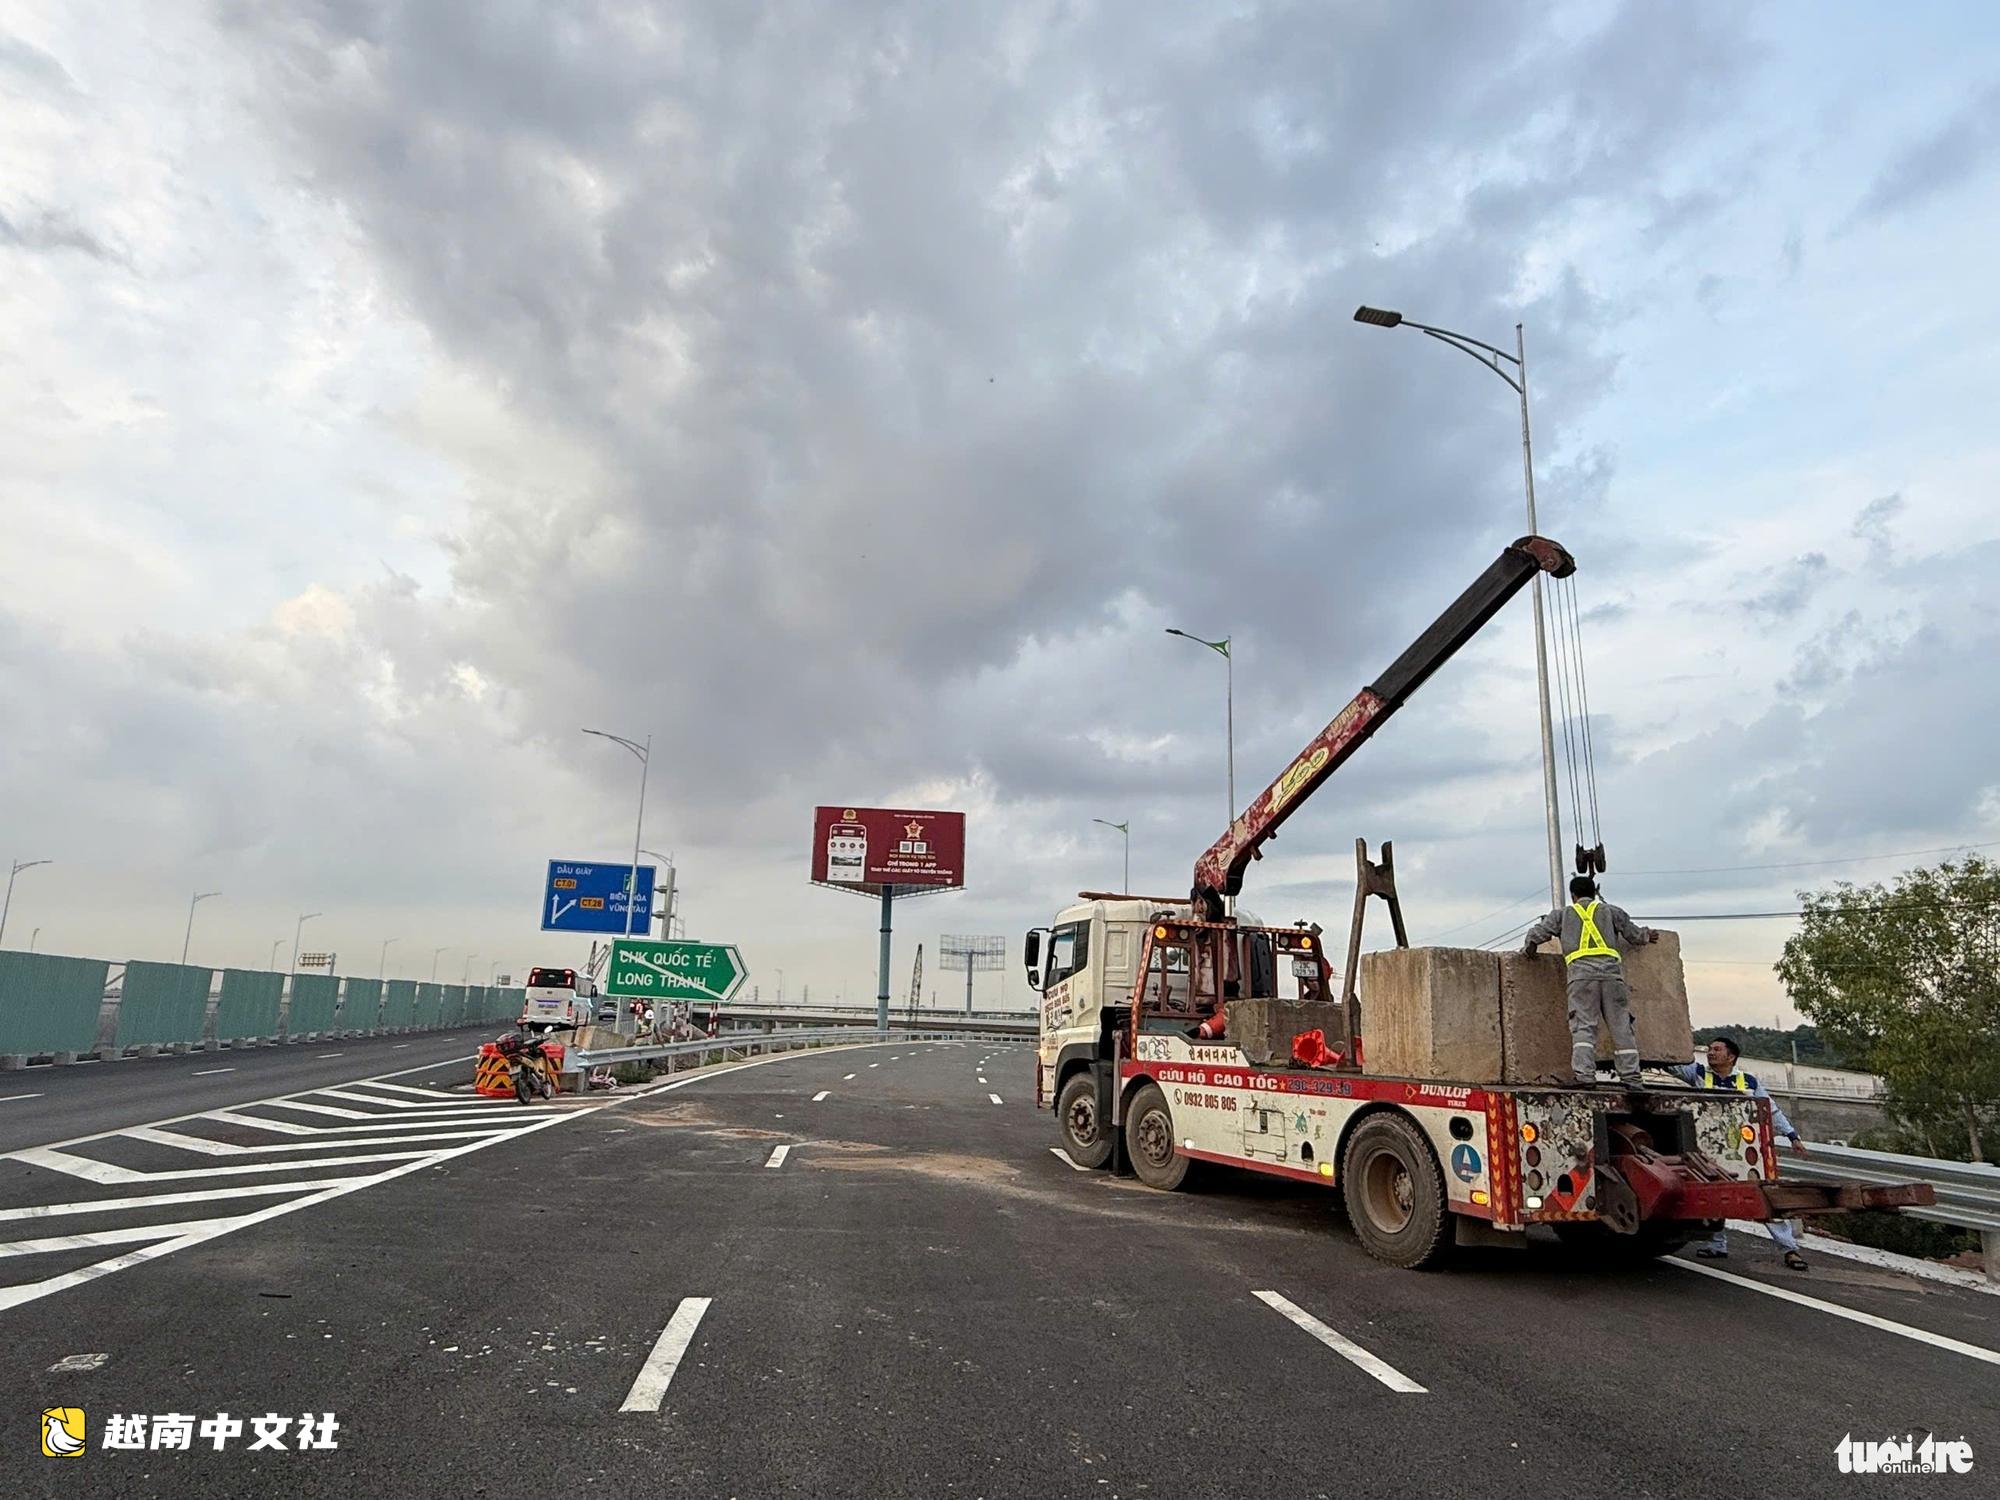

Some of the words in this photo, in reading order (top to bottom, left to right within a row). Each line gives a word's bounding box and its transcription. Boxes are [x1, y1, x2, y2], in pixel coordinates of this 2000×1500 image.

[620, 950, 648, 964] CHK
[653, 947, 690, 967] QUỐC
[617, 972, 653, 986] LONG
[659, 972, 706, 988] THÀNH
[1159, 1067, 1184, 1082] CỨU
[1187, 1069, 1206, 1084] HỘ
[1213, 1073, 1243, 1087] CAO
[1247, 1073, 1278, 1090] TỐC
[1420, 1084, 1472, 1099] DUNLOP
[1184, 1092, 1203, 1107] 0932
[1204, 1094, 1219, 1109] 805
[1221, 1096, 1237, 1111] 805
